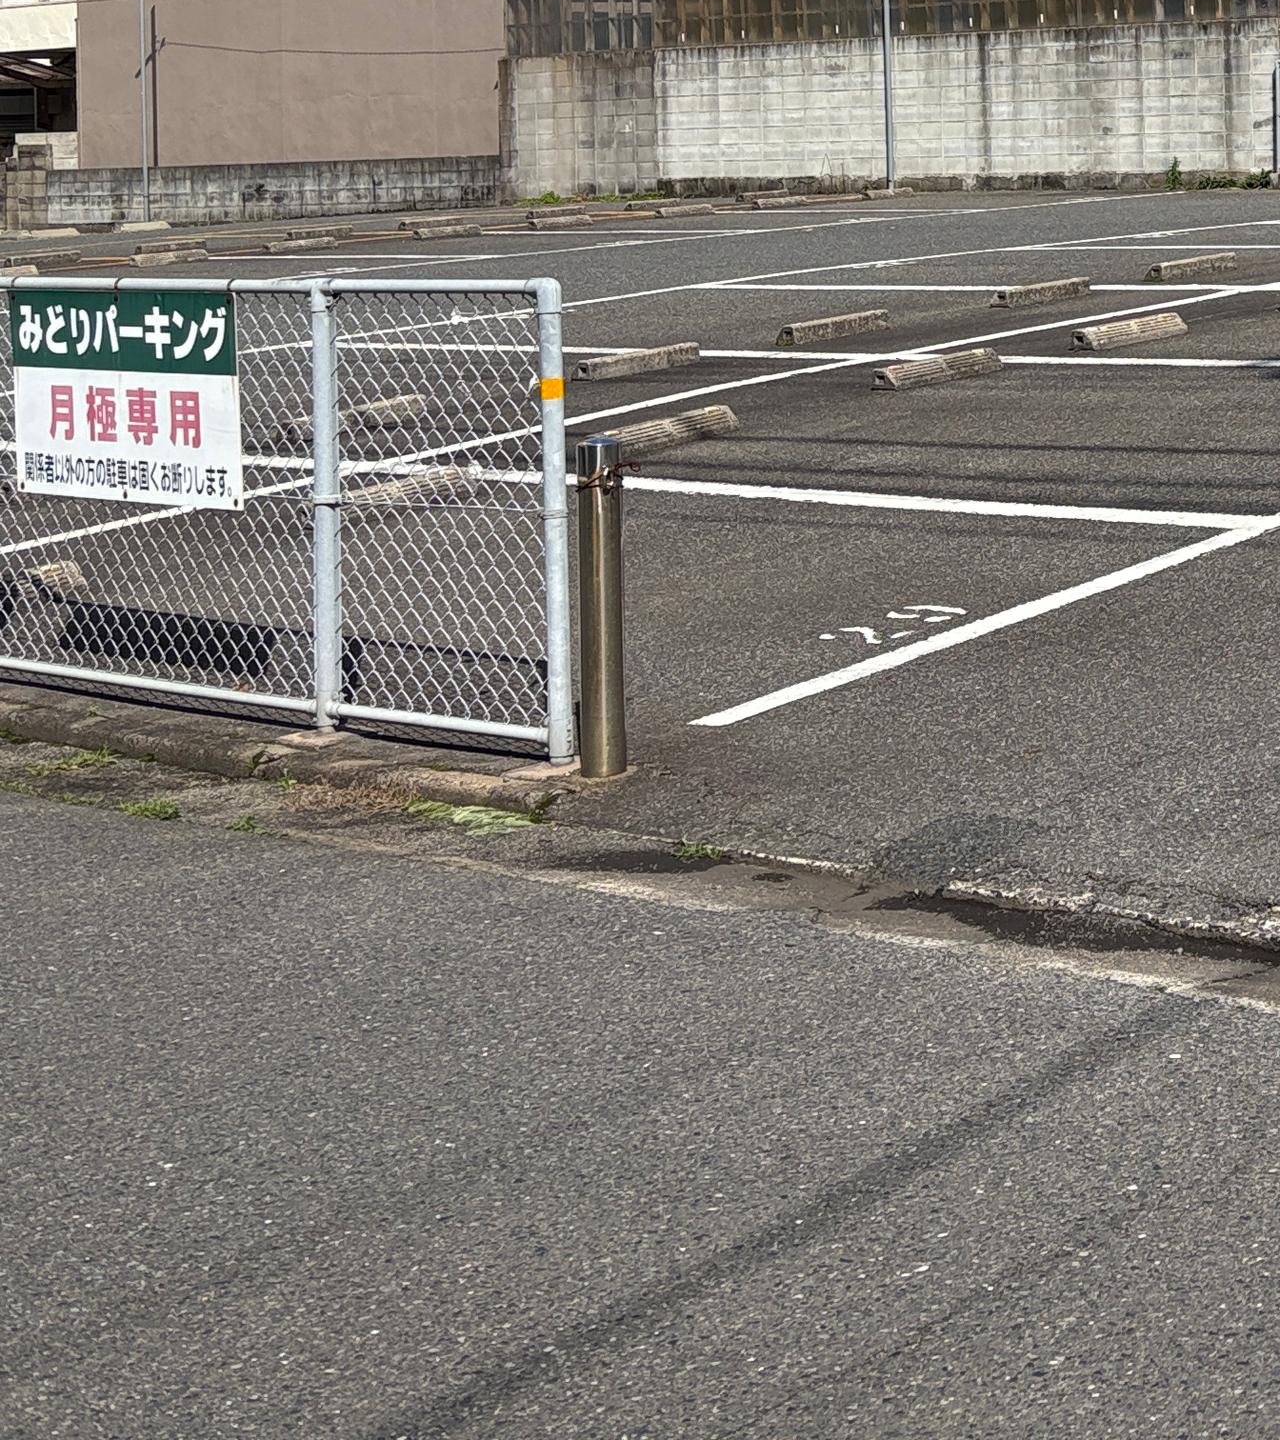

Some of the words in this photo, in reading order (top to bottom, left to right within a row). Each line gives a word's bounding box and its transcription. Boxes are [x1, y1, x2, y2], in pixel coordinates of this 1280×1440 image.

[19, 304, 227, 362] みどりパーキング
[49, 384, 202, 449] 月極専用
[24, 451, 233, 498] 関係者以外の方の駐車は固くお断りします。
